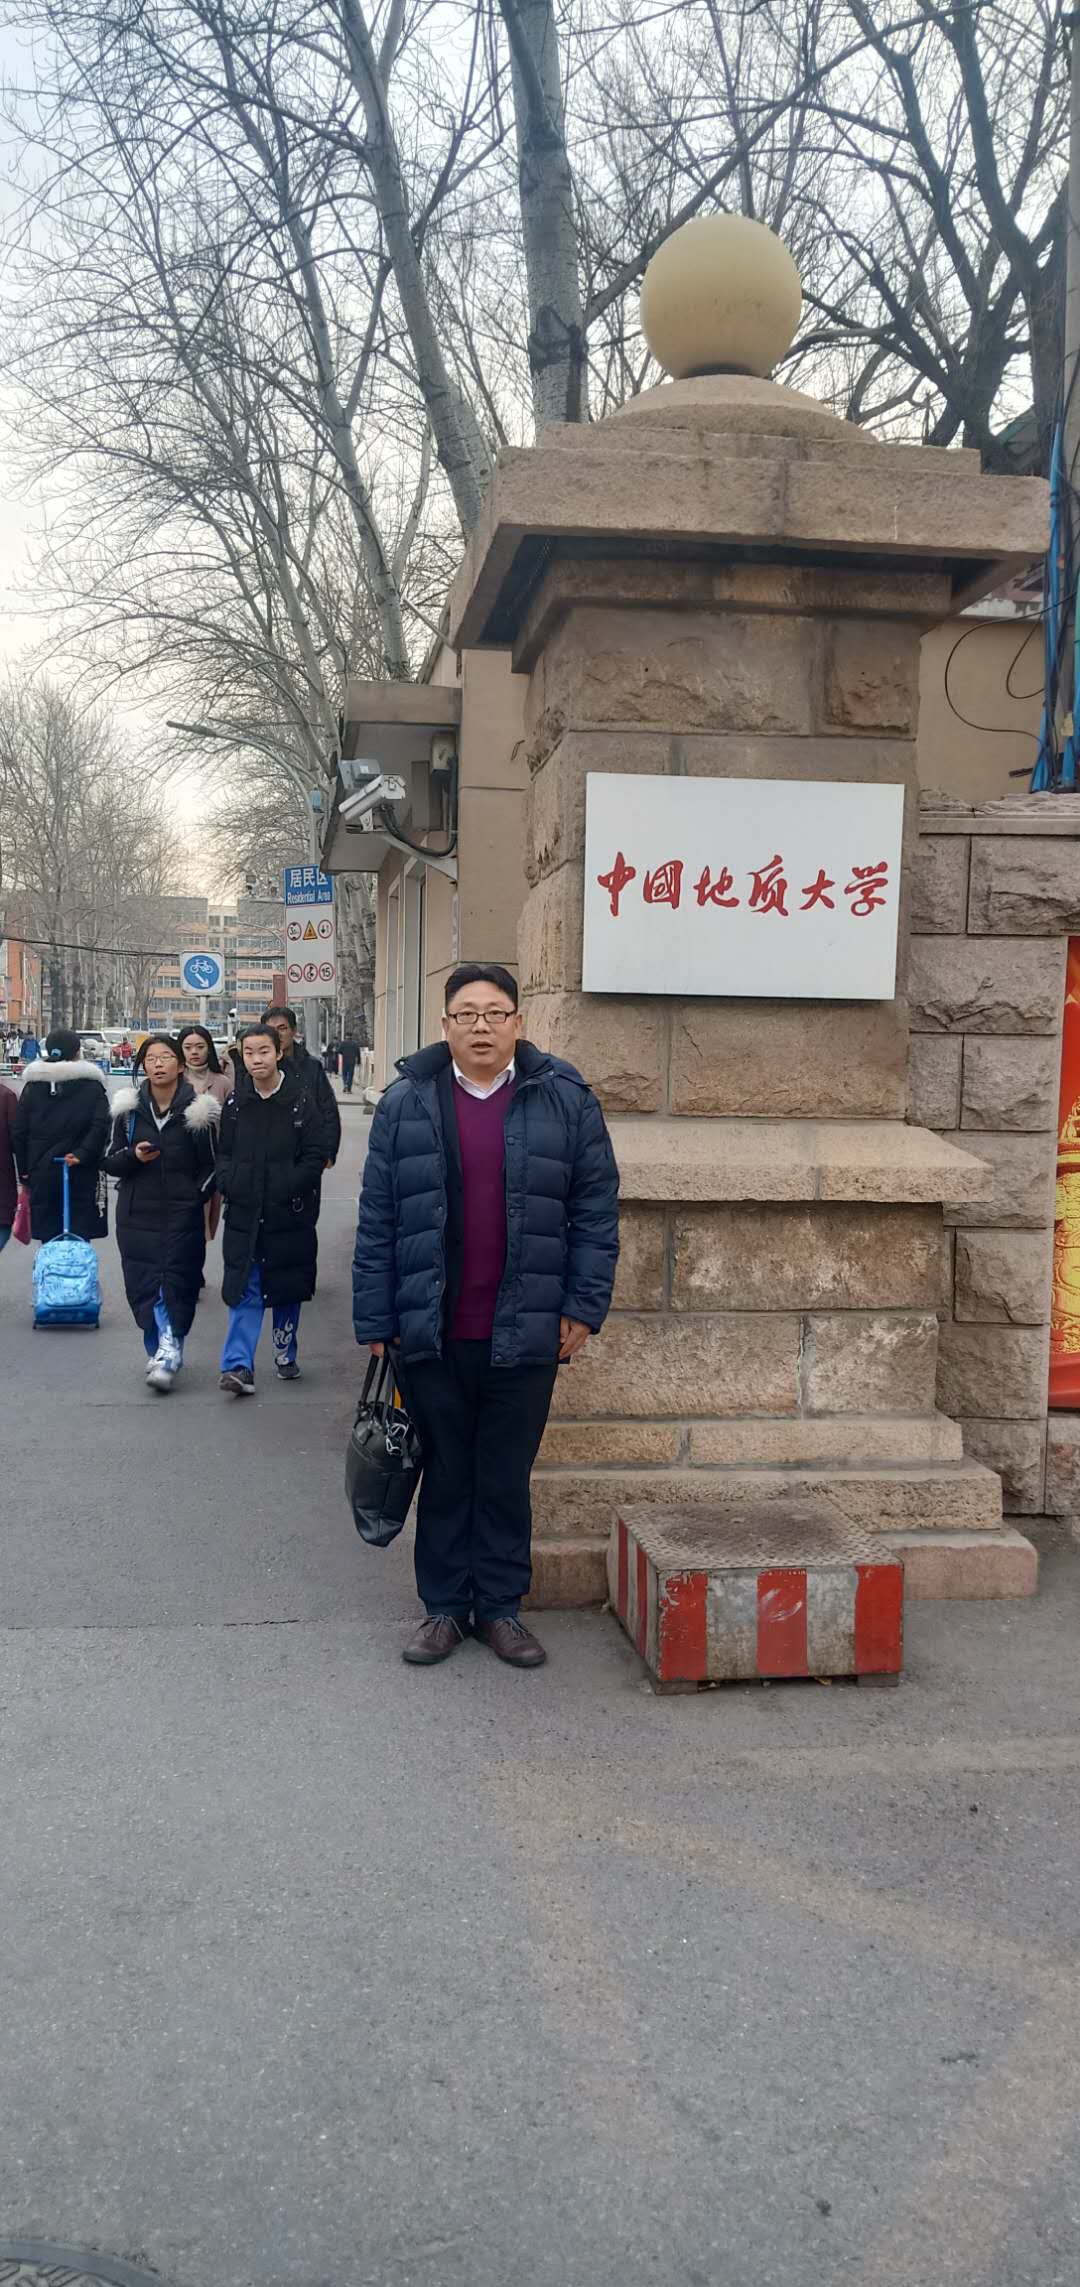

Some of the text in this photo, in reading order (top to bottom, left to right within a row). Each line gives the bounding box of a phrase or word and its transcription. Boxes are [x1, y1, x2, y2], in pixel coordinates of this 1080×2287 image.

[287, 890, 331, 904] Residential Area
[322, 967, 331, 977] 15
